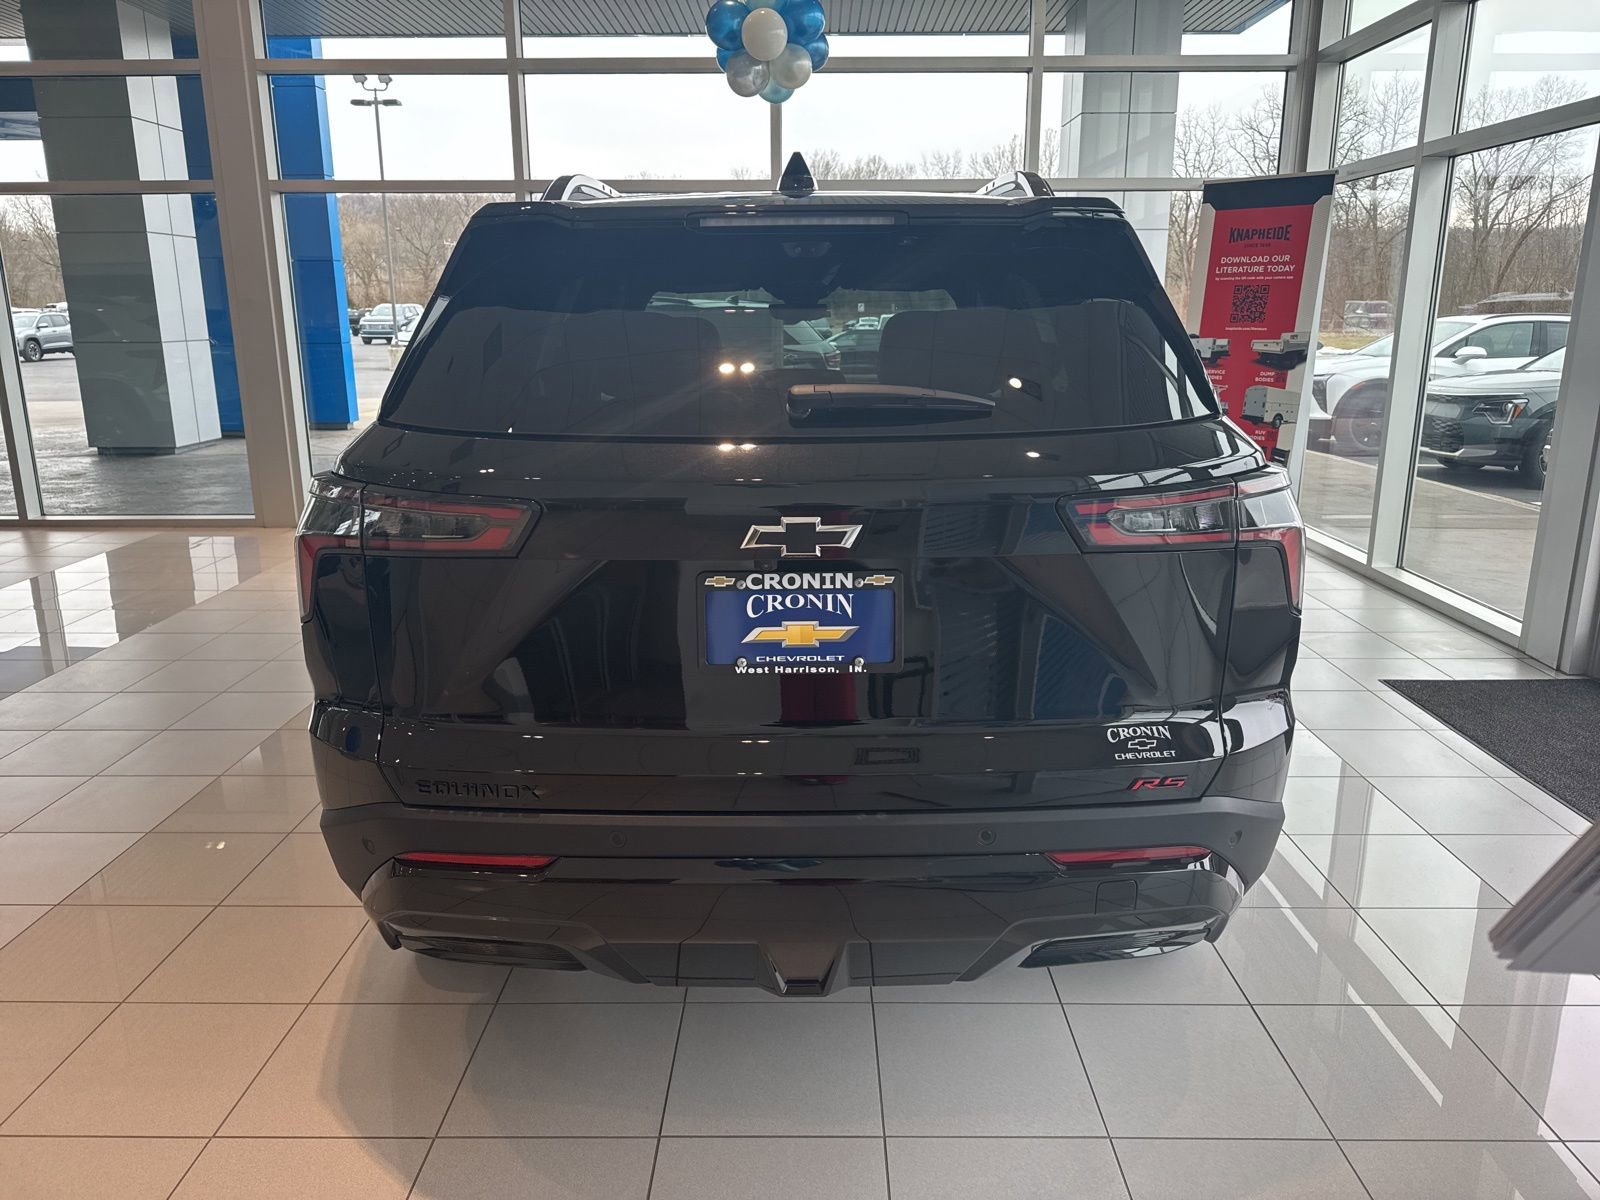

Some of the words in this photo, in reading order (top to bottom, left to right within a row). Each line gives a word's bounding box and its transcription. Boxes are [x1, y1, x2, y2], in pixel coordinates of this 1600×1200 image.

[1228, 224, 1292, 244] KNAPHEIDE
[1221, 255, 1270, 264] DOWNLOAD
[1216, 266, 1264, 274] LITERATURE
[746, 573, 853, 590] CRONIN
[746, 594, 853, 618] CRONIN
[1107, 726, 1171, 743] CRONIN
[1115, 750, 1176, 760] CHEVROLET
[415, 779, 540, 799] EQUINOX
[1127, 775, 1189, 791] RS
